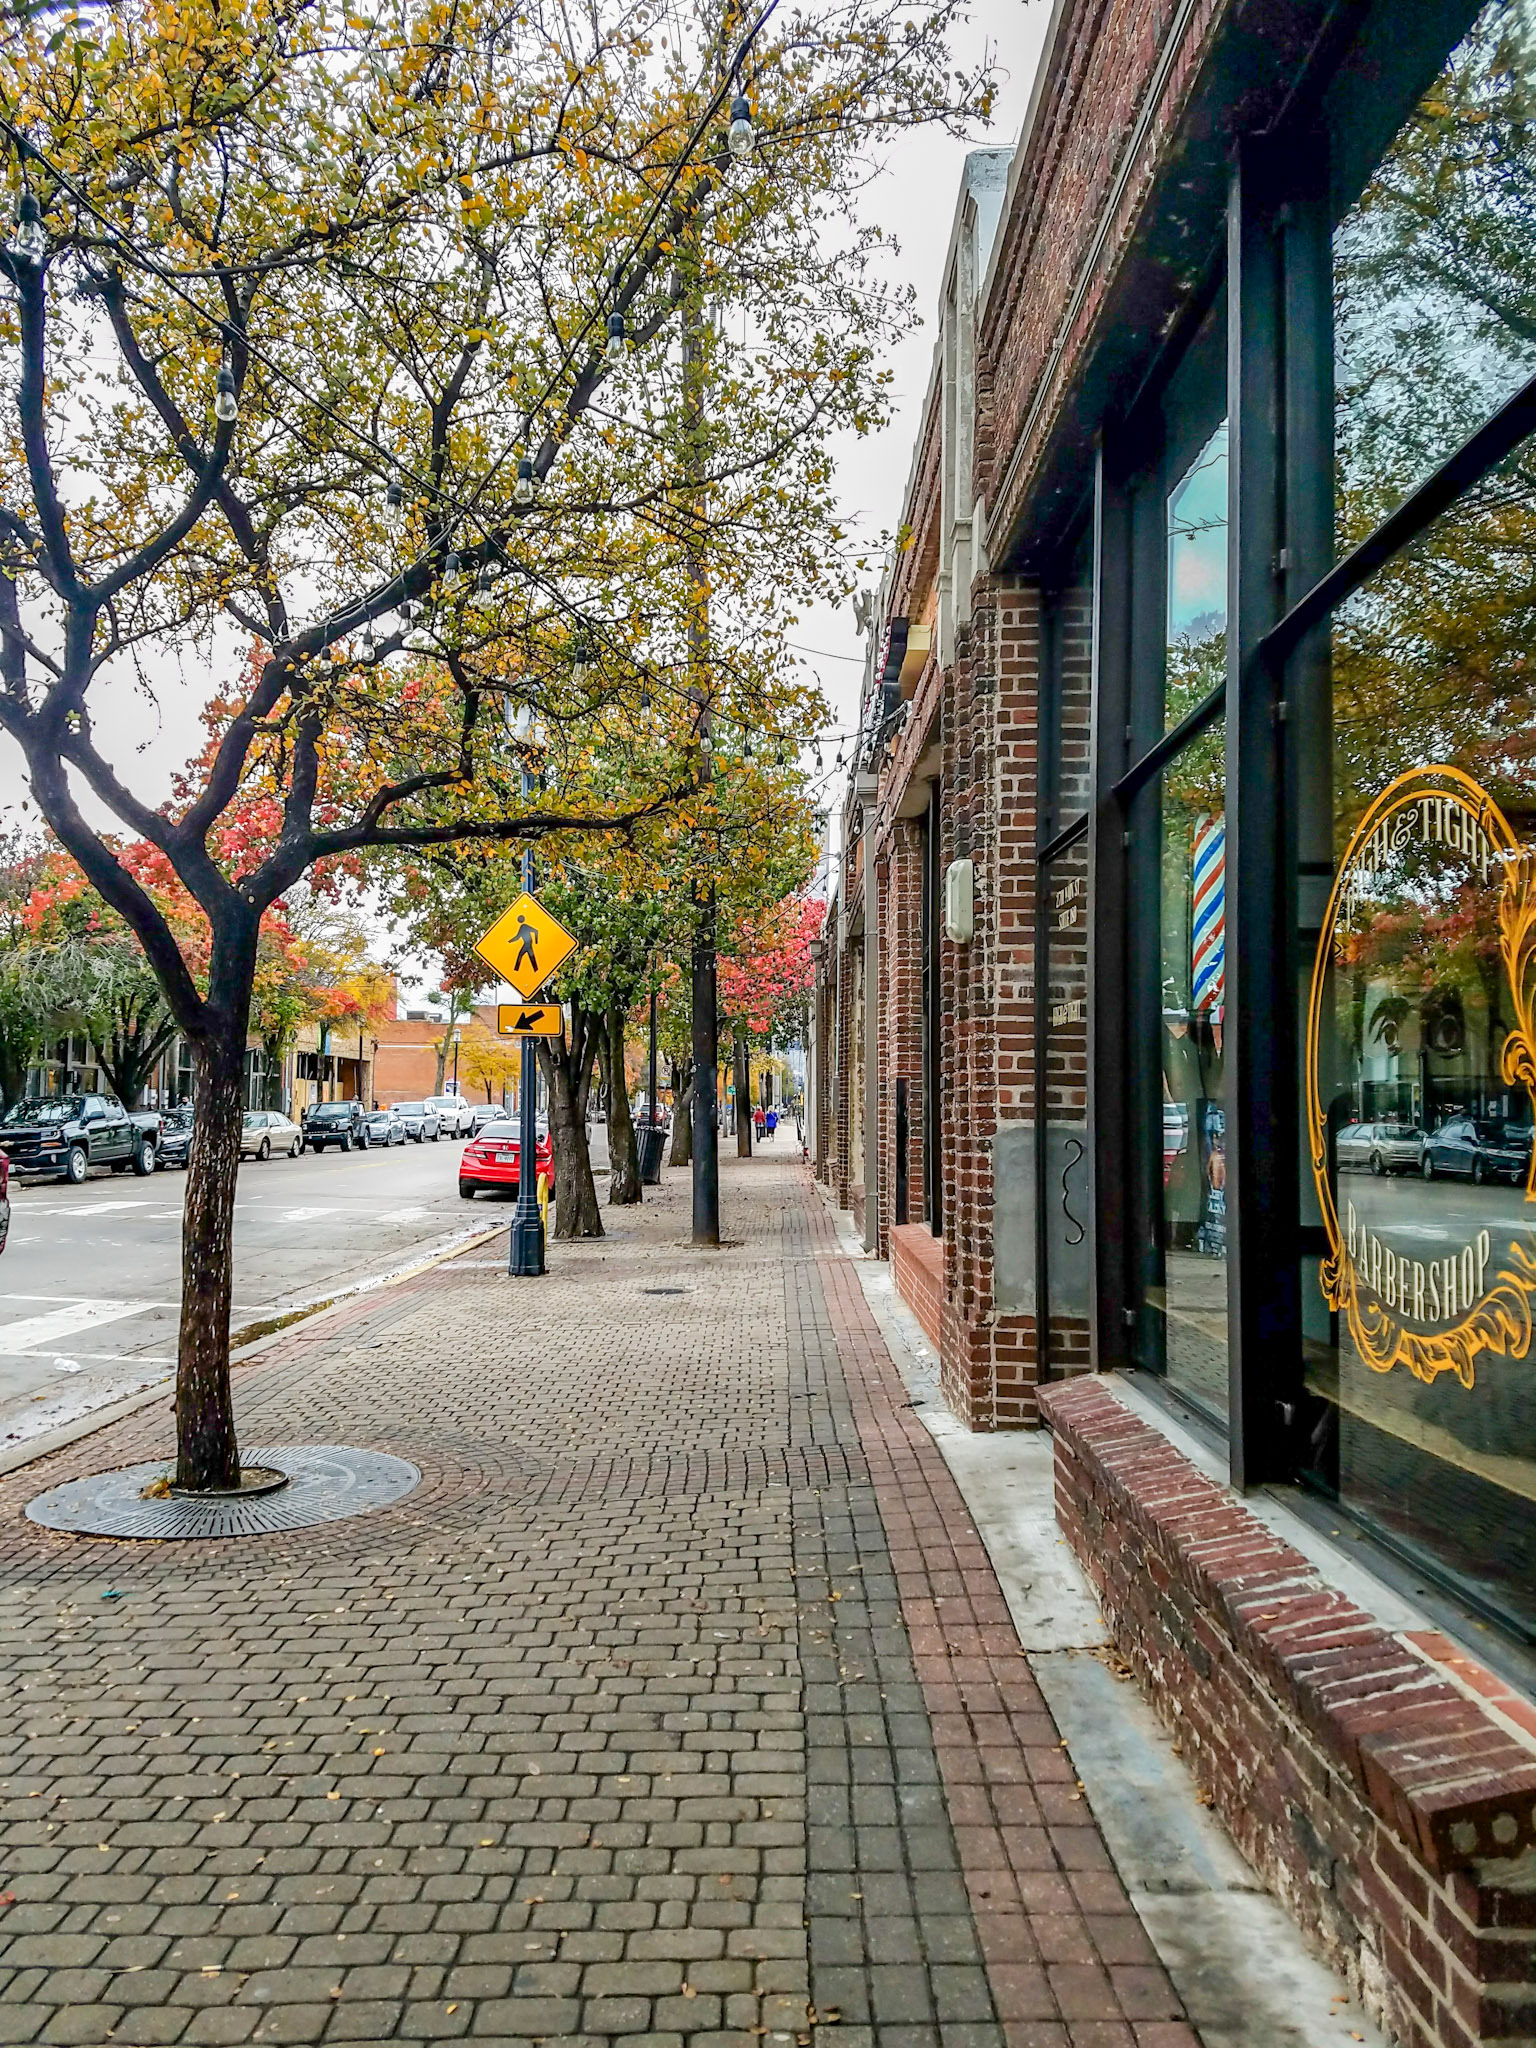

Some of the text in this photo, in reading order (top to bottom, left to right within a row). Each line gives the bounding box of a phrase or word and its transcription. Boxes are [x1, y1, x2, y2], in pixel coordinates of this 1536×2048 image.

[1346, 797, 1490, 933] HIGH & TIGHT
[1347, 1198, 1491, 1323] BARBERSHOP
